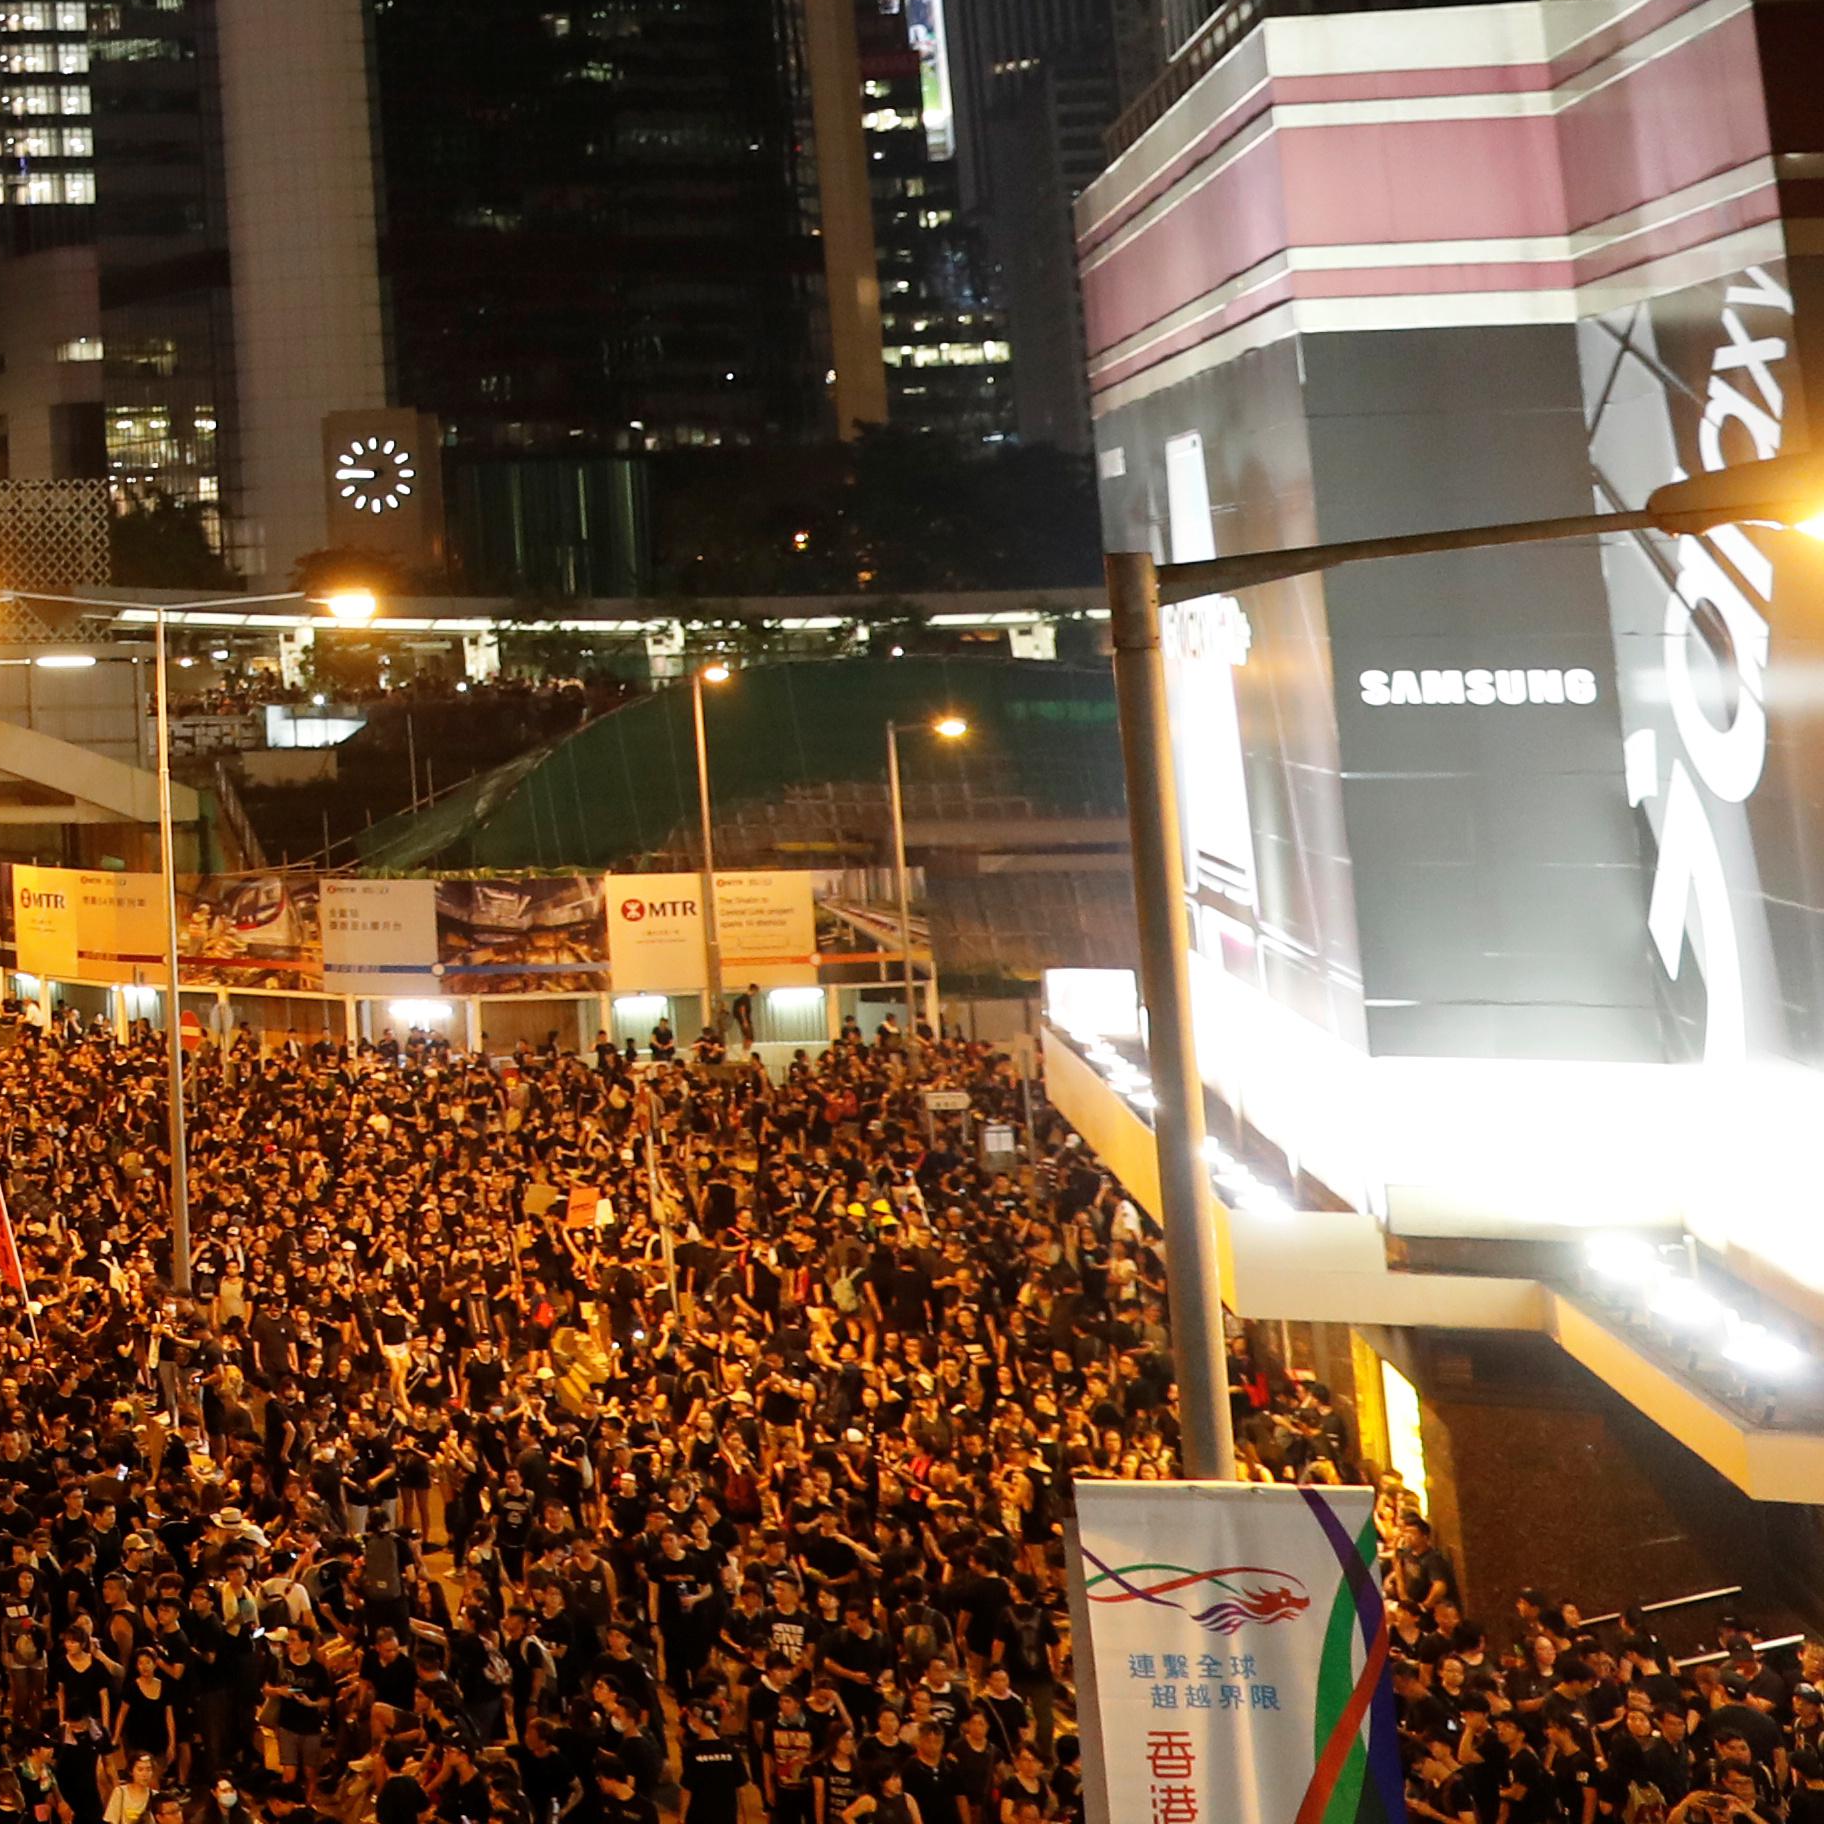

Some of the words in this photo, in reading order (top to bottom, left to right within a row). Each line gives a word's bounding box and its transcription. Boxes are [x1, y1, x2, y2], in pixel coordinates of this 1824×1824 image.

[1359, 667, 1598, 706] SAMSUNG
[33, 892, 65, 909] MTR
[649, 900, 697, 918] MTR
[1128, 1653, 1257, 1679] 連繫全球
[1150, 1684, 1281, 1711] 超越界限
[1146, 1730, 1199, 1824] 香港
